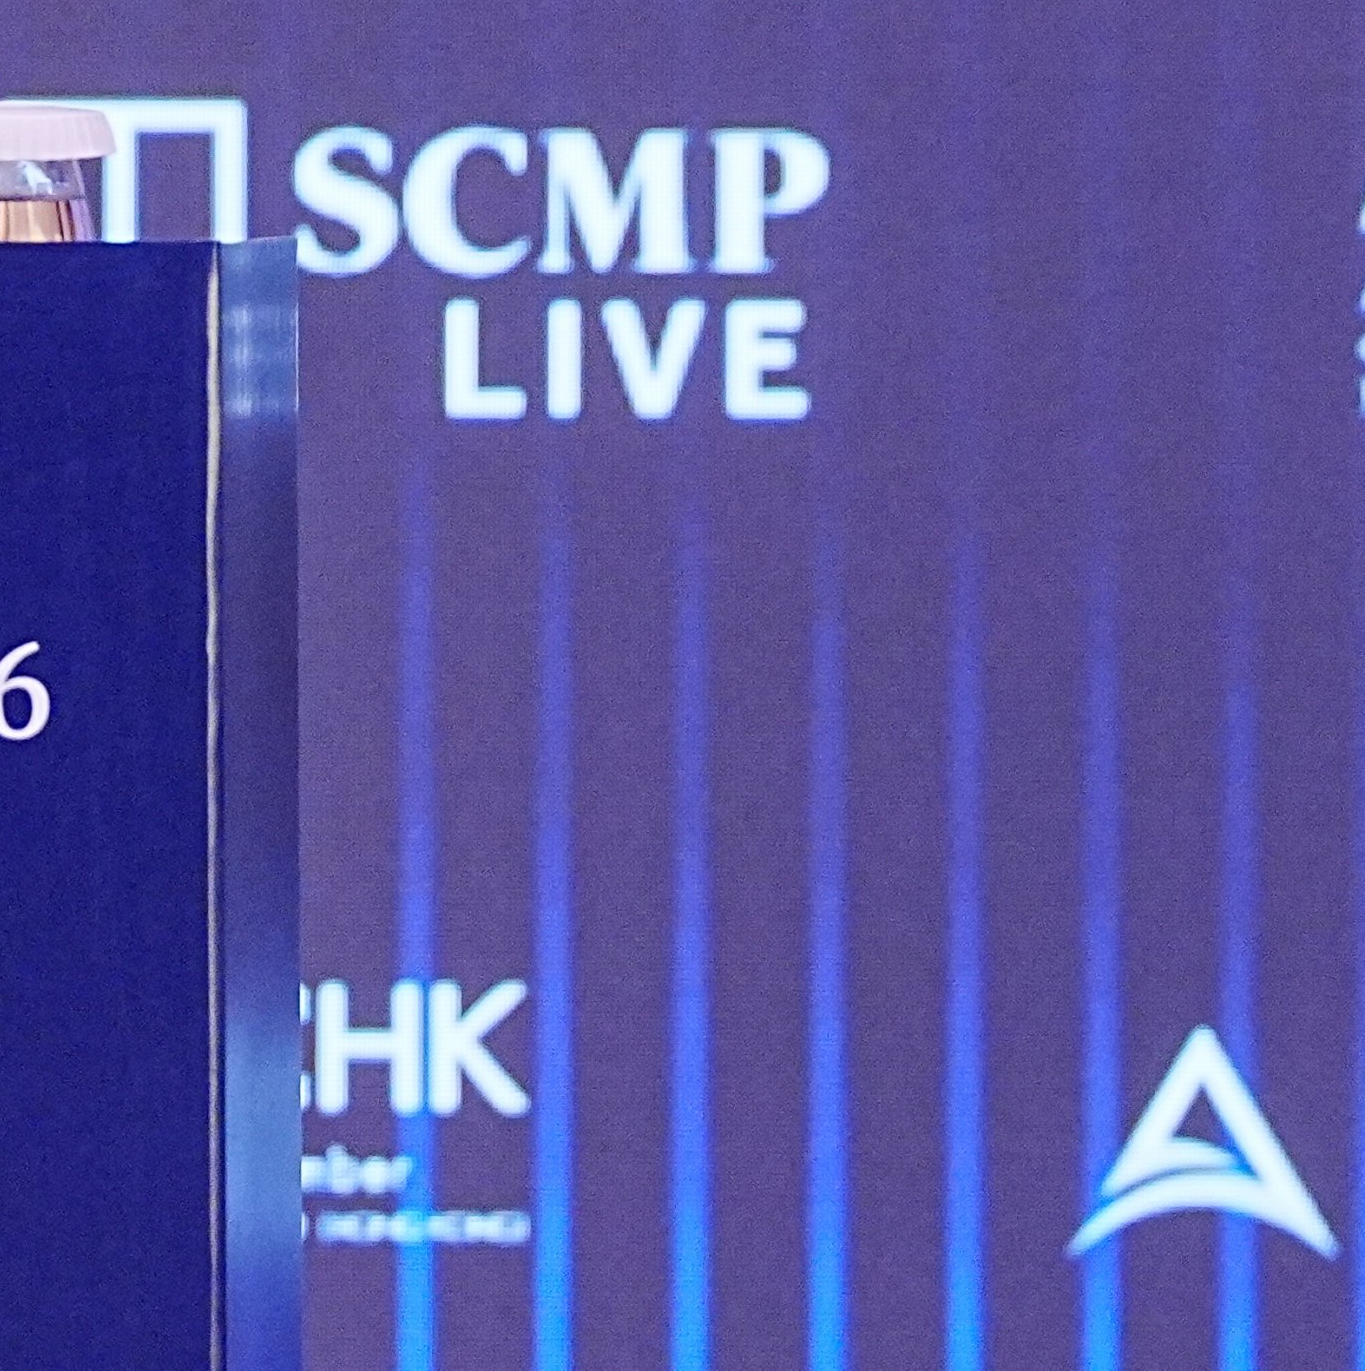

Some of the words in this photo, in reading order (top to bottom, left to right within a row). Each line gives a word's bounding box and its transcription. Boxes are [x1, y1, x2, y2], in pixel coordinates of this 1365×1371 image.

[295, 128, 829, 276] SCMP
[445, 301, 808, 418] LIVE
[301, 983, 527, 1114] HK
